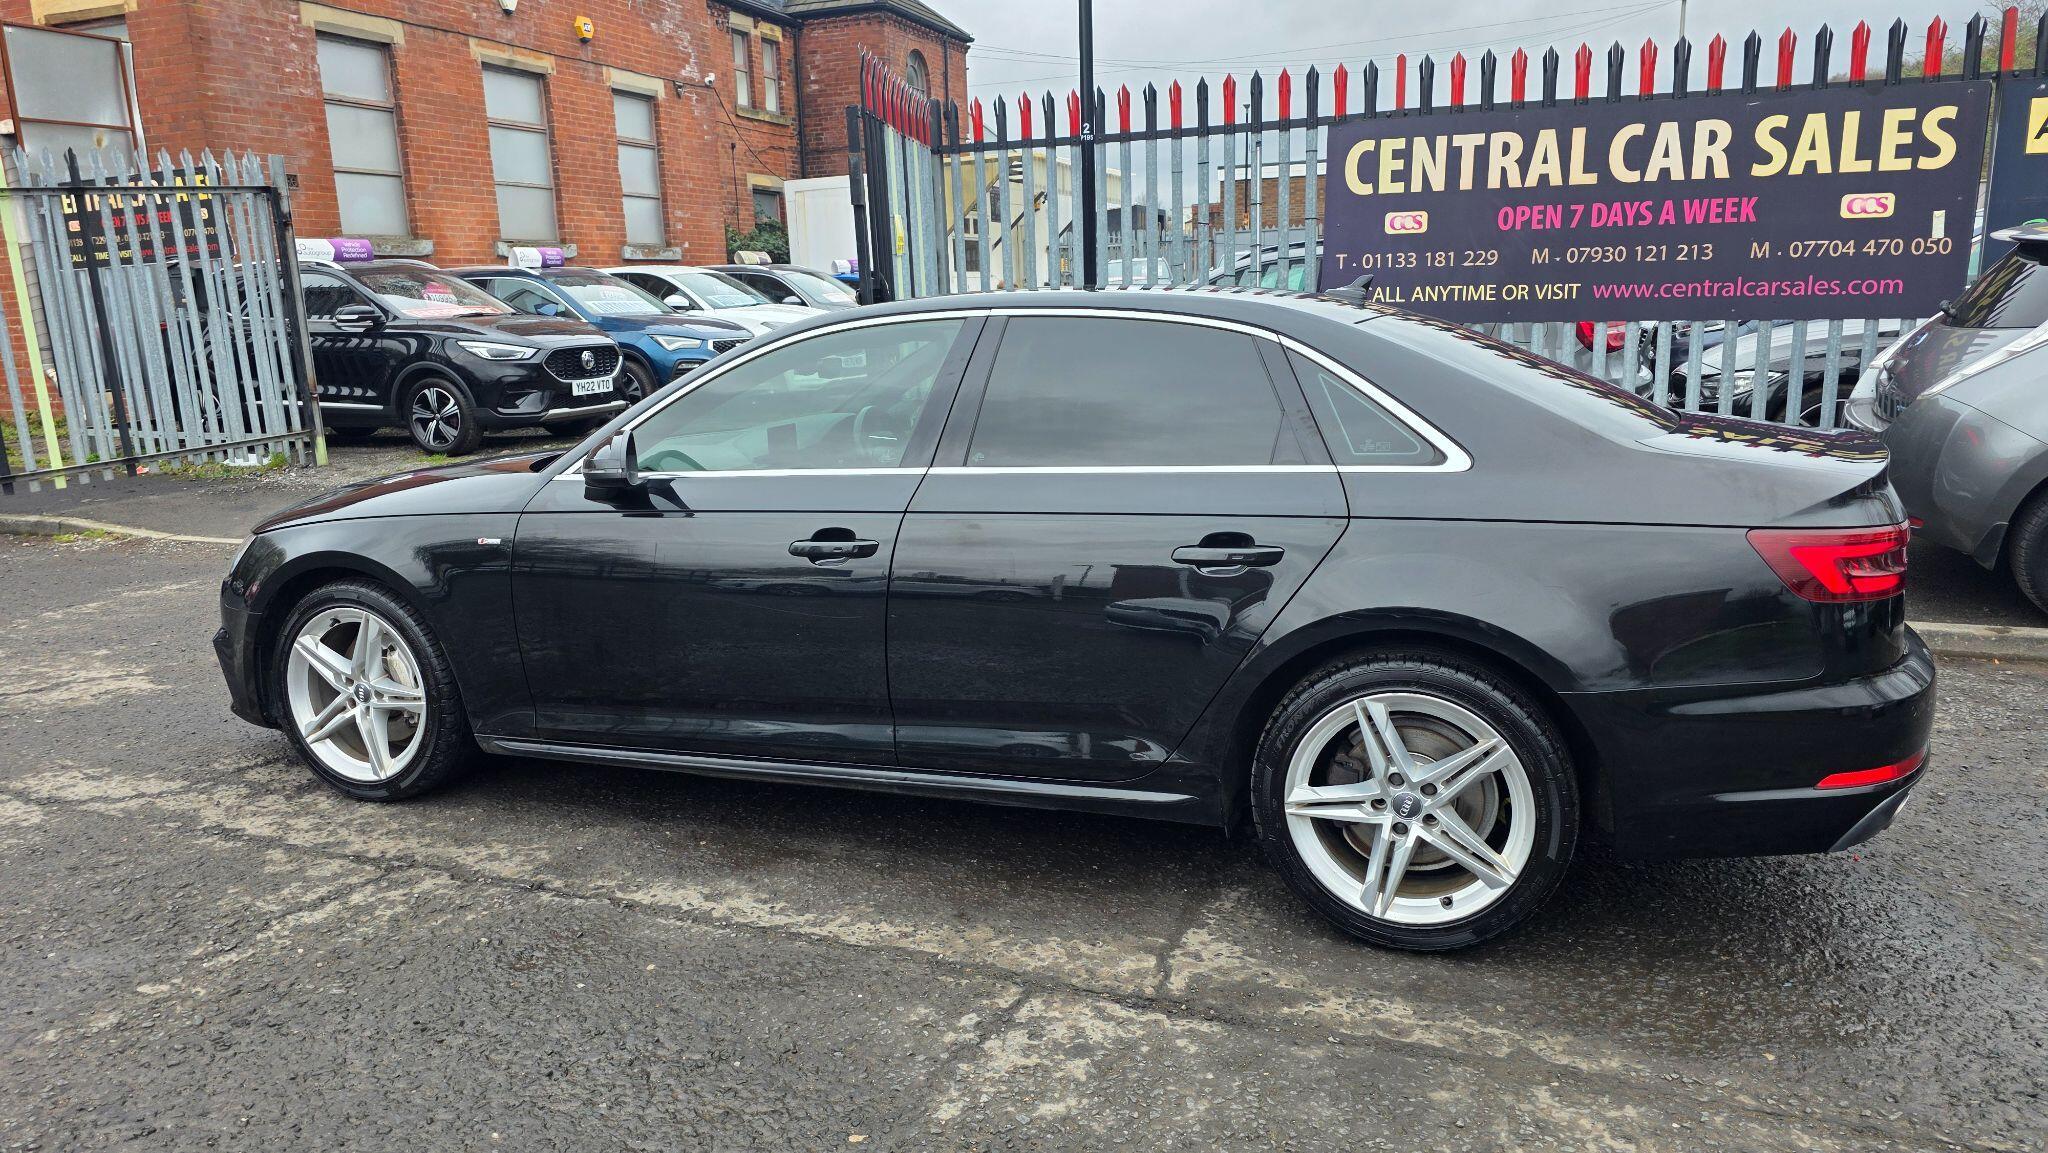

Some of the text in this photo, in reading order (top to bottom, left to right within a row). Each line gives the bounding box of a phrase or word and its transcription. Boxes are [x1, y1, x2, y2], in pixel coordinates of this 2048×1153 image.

[1083, 123, 1091, 134] 2
[1344, 105, 1959, 196] CENTRAL CAR SALES
[1497, 197, 1759, 231] OPEN 7 DAYS A WEEK
[1532, 248, 1549, 265] M
[1566, 246, 1627, 264] 07930
[1634, 245, 1667, 263] 121
[1676, 243, 1714, 261] 213
[1750, 241, 1770, 259] M
[1789, 239, 1857, 258] 07704
[1862, 238, 1904, 257] 470
[1911, 236, 1952, 256] 050
[1336, 254, 1348, 269] T
[1362, 252, 1417, 269] 01133
[1425, 251, 1455, 268] 181
[1461, 250, 1499, 267] 229
[1368, 275, 1904, 303] ALL ANYTIME OR VISIT www.centralcarsales.com
[576, 381, 596, 393] YH22
